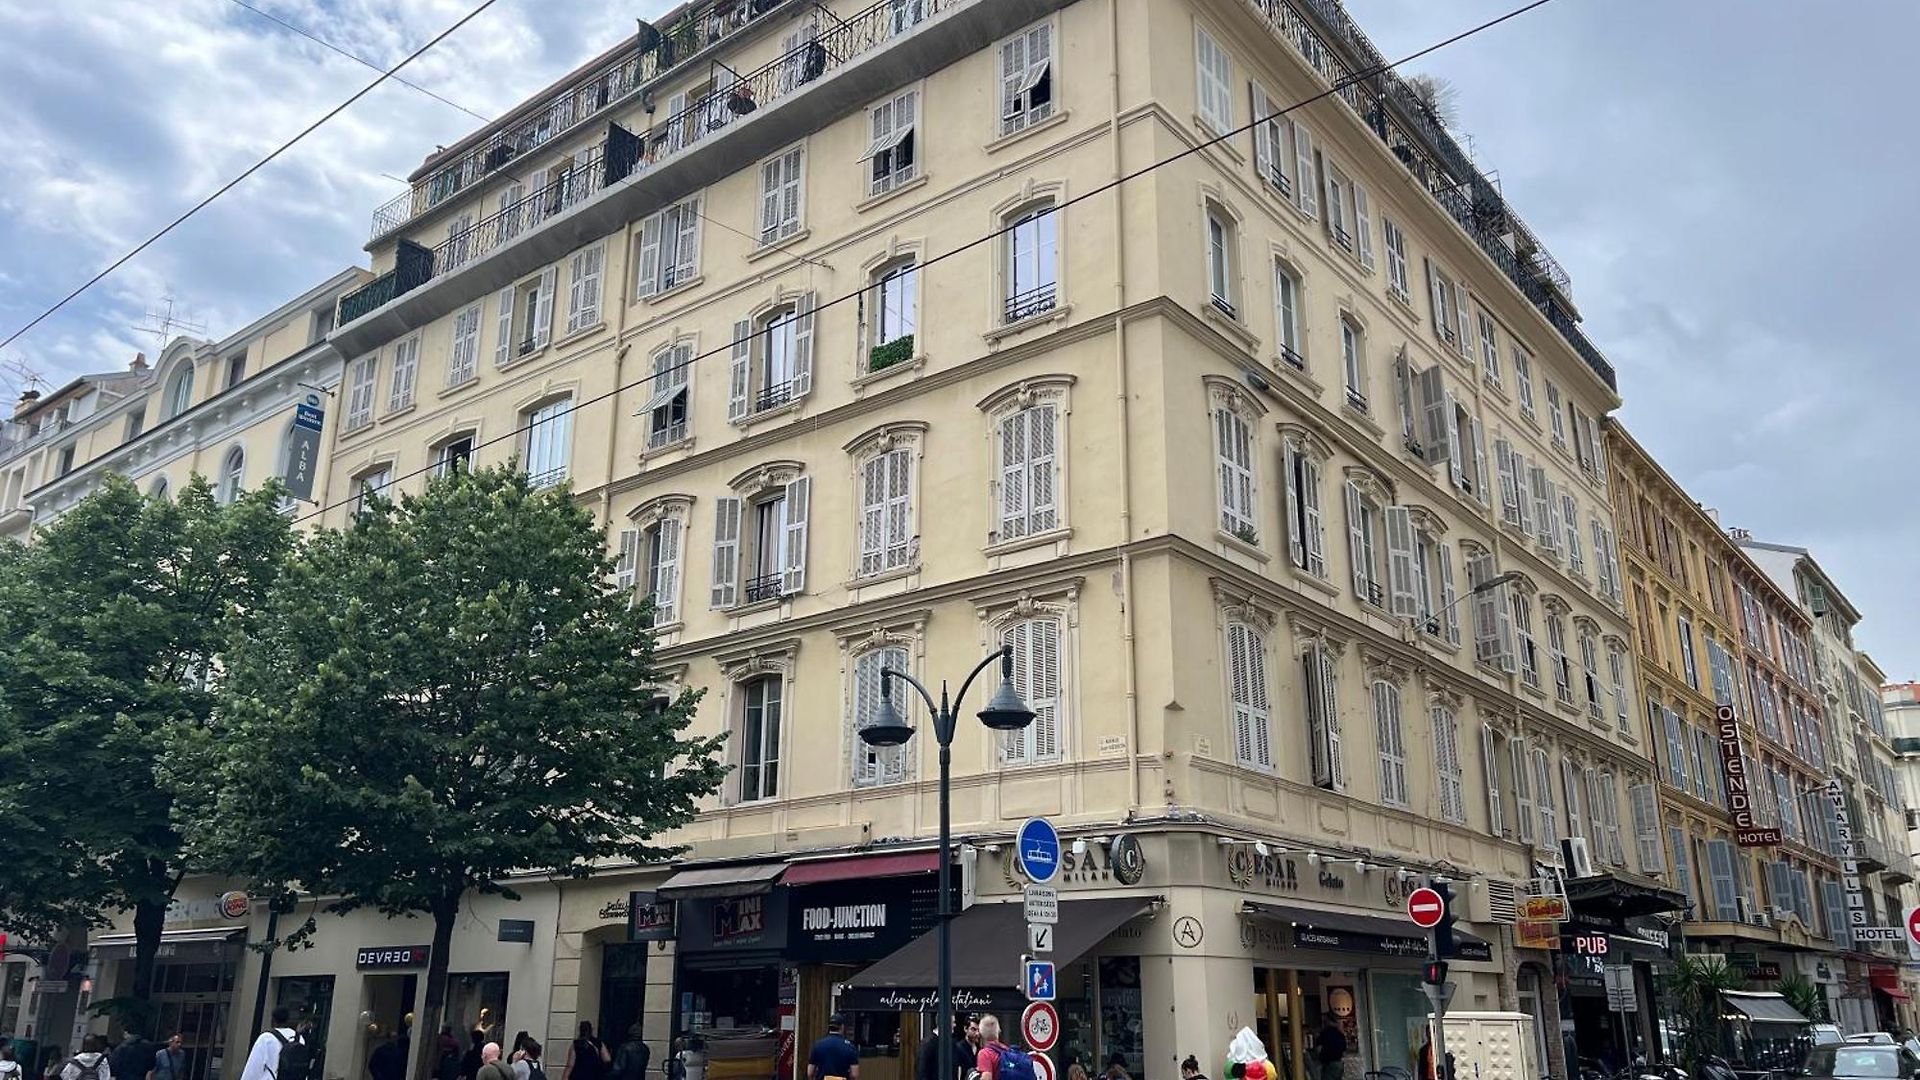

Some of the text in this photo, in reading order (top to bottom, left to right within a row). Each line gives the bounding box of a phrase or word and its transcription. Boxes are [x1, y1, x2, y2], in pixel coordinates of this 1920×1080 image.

[296, 440, 309, 482] ALBA
[1717, 706, 1750, 828] OSTENDE
[1738, 832, 1780, 844] HOTEL
[1829, 780, 1863, 923] AMARYLLIS
[1063, 871, 1110, 882] MILAN
[1235, 851, 1297, 881] CESAR
[1319, 871, 1344, 890] Gelato
[803, 904, 886, 930] FOOD-JUNCTION
[1576, 936, 1608, 954] PUB
[1856, 929, 1902, 939] HOTEL
